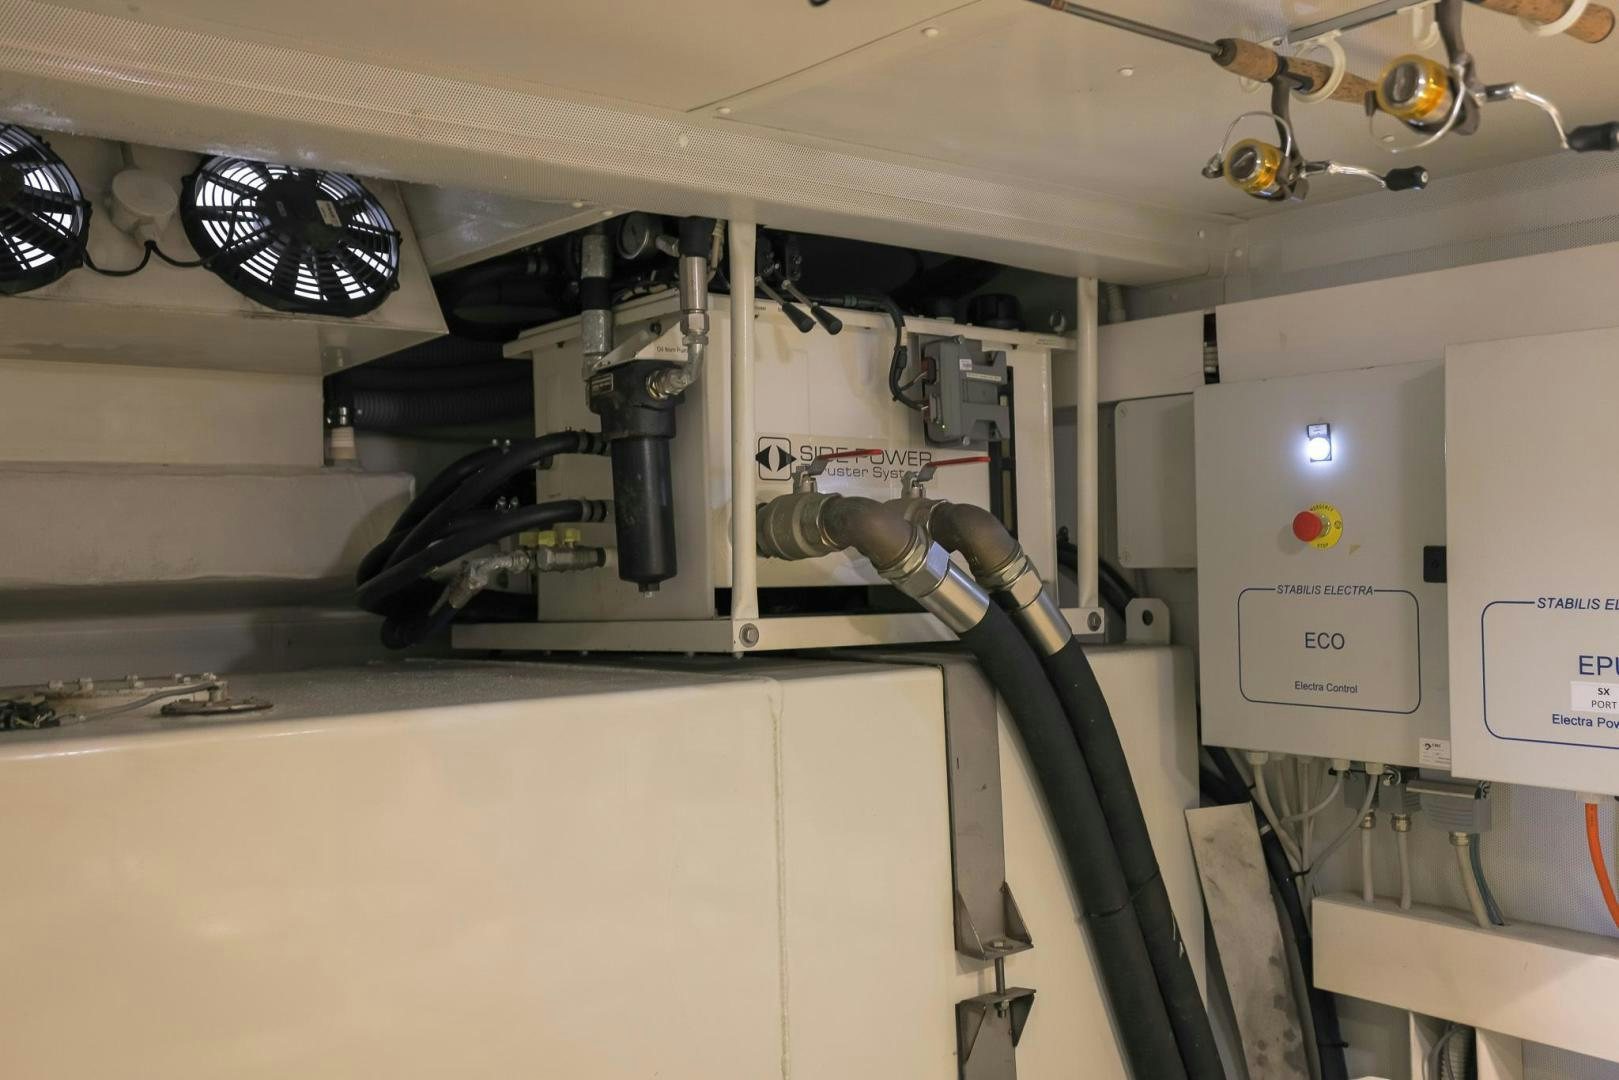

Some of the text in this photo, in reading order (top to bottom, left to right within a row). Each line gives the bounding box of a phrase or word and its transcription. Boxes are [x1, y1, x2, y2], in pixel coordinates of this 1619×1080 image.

[1277, 585, 1373, 596] STABILIS ELECTRA
[1537, 598, 1600, 610] STABILIS
[1305, 632, 1345, 650] ECO
[1294, 681, 1358, 694] Electra Control
[1597, 688, 1610, 696] SX
[1591, 700, 1617, 709] PORT
[1552, 714, 1593, 727] Electra
